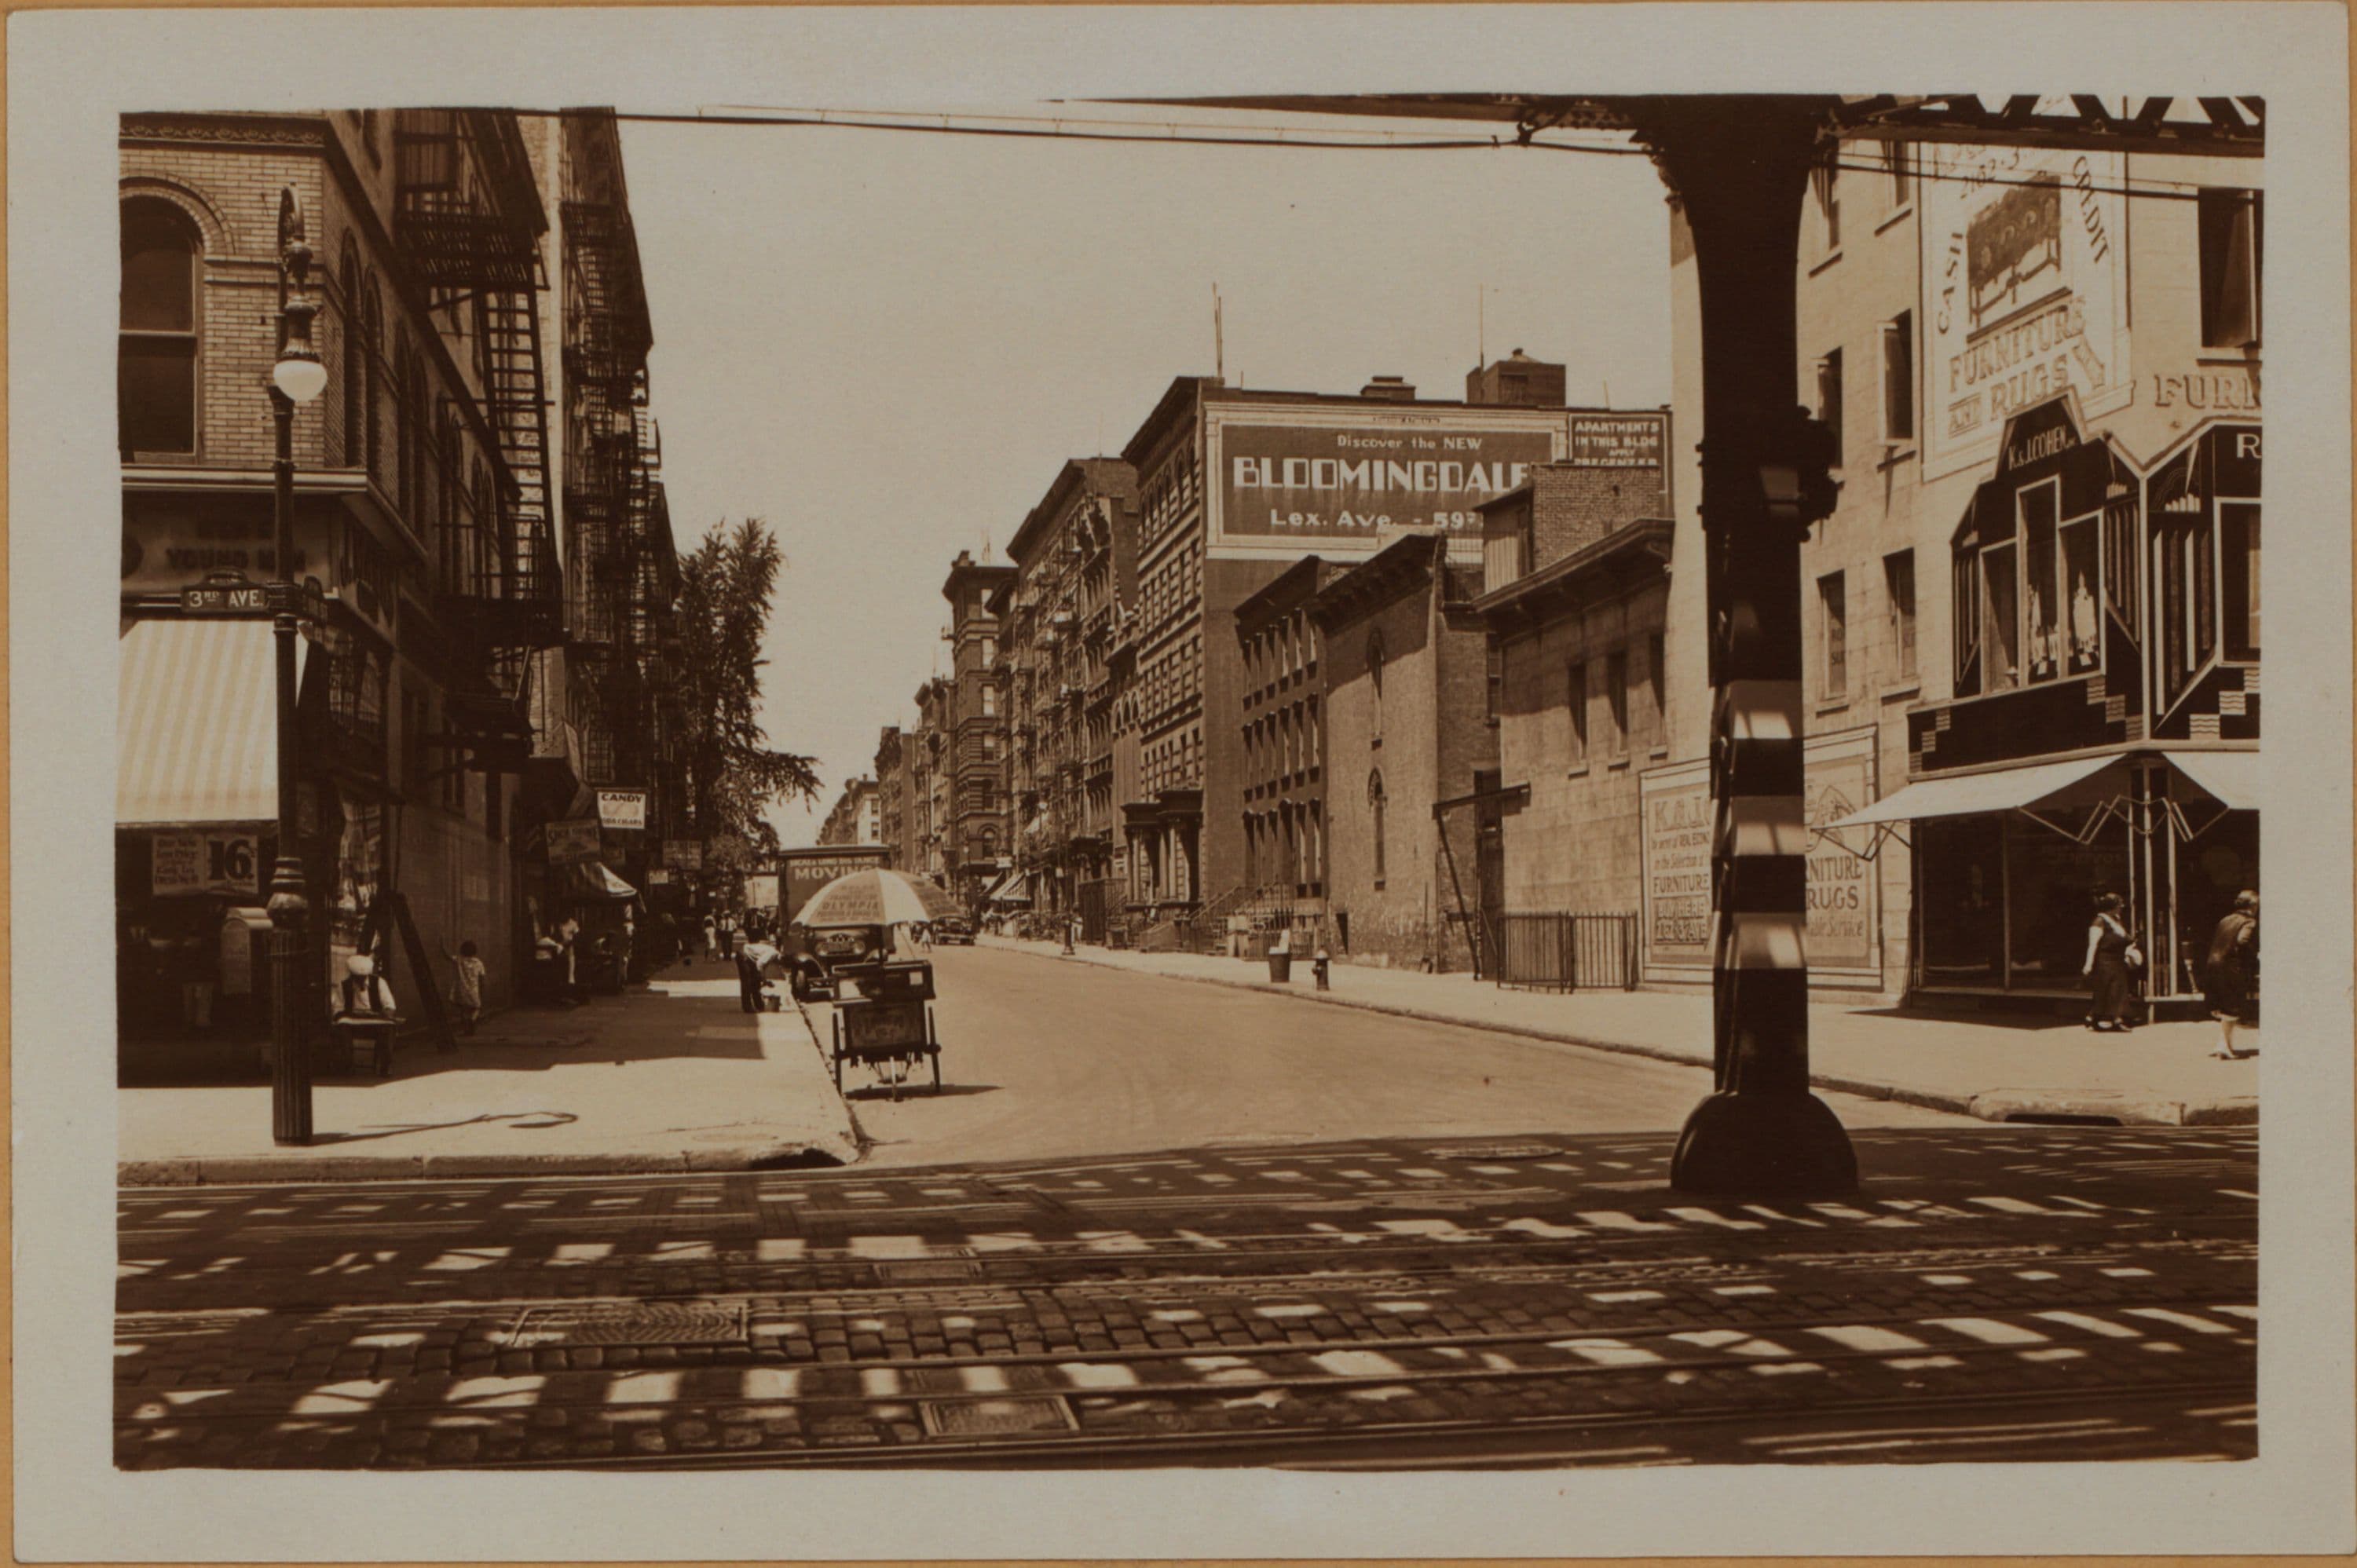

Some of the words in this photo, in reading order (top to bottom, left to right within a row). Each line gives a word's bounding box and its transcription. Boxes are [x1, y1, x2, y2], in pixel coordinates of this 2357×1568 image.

[1937, 232, 1964, 335] CASH
[1949, 297, 2086, 393] FURNITURE
[1990, 353, 2069, 422] RUGS
[1574, 421, 1659, 433] APARTMENTS
[1337, 434, 1403, 451] Discover
[1411, 436, 1436, 451] the
[1443, 436, 1483, 451] NEW
[1576, 436, 1588, 447] IN
[1592, 436, 1618, 447] THIS
[1623, 436, 1658, 448] BLDG
[1270, 509, 1329, 528] Lex.
[1337, 510, 1397, 529] Ave.
[189, 590, 221, 608] 3RD
[227, 589, 265, 607] AVE.
[602, 792, 643, 803] CANDY
[1652, 872, 1710, 894] FURNITURE
[822, 901, 880, 911] OLYMPIA
[1806, 884, 1860, 911] RUGS
